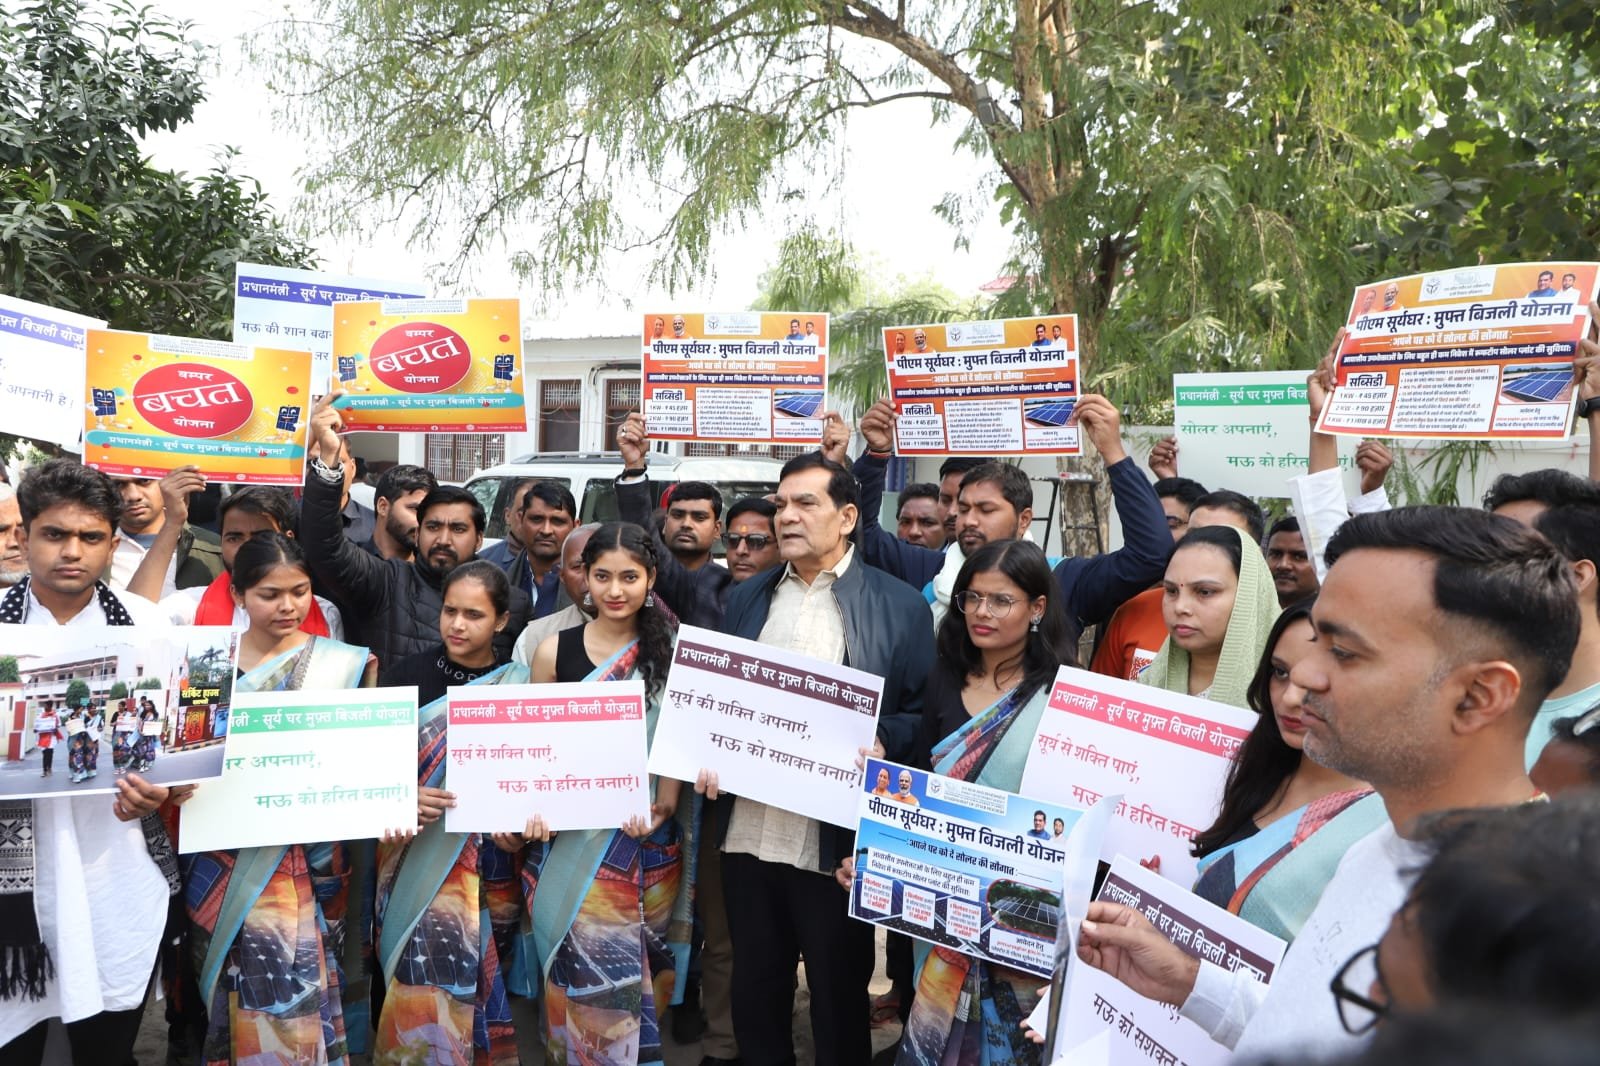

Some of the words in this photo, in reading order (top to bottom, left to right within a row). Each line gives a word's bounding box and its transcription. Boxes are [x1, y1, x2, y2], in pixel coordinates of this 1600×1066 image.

[242, 281, 290, 296] प्रधानमंत्री
[300, 286, 316, 301] सूर्य
[319, 290, 332, 300] घर
[1356, 316, 1384, 331] पीएम
[1387, 313, 1424, 333] सूर्यघर
[1435, 308, 1464, 329] मुफ्त
[1469, 301, 1517, 322] बिजली
[1520, 300, 1574, 318] योजना
[21, 317, 57, 338] बिजली
[241, 322, 260, 332] मऊ
[265, 322, 279, 334] की
[284, 326, 306, 338] शान
[405, 329, 434, 338] बम्पर
[373, 336, 461, 372] बचत
[653, 341, 678, 354] पीएम
[681, 341, 712, 358] सूर्यघर
[719, 343, 742, 358] मुफ्त
[745, 341, 779, 355] बिजली
[782, 341, 816, 355] योजना
[897, 355, 922, 369] पीएम
[925, 354, 955, 372] सूर्यघर
[964, 354, 988, 369] मुफ्त
[990, 349, 1026, 364] बिजली
[1030, 348, 1065, 361] योजना
[178, 370, 213, 381] बम्पर
[403, 373, 439, 383] योजना
[1350, 373, 1383, 387] सब्सिडी
[7, 385, 53, 403] अपनानी
[136, 382, 243, 413] बचत
[655, 390, 682, 401] सब्सिडी
[1179, 388, 1219, 401] प्रधानमंत्री
[1230, 388, 1244, 404] सूर्य
[1247, 391, 1260, 400] घर
[905, 405, 932, 416] सब्सिडी
[173, 416, 215, 429] योजना
[1181, 421, 1218, 434] सोलर
[1227, 456, 1255, 467] मऊ
[1259, 452, 1274, 466] को
[1278, 452, 1309, 467] हरित
[680, 647, 731, 669] प्रधानमंत्री
[741, 659, 759, 679] सूर्य
[761, 668, 776, 681] घर
[805, 675, 839, 698] बिजली
[841, 686, 874, 709] योजना
[453, 703, 496, 718] प्रधानमंत्री
[507, 701, 522, 720] सूर्य
[525, 706, 540, 716] घर
[567, 700, 601, 715] बिजली
[604, 699, 637, 714] योजना
[669, 688, 695, 709] सूर्य
[696, 694, 716, 710] की
[718, 700, 755, 722] शक्ति
[1055, 689, 1098, 711] प्रधानमंत्री
[1107, 701, 1126, 723] सूर्य
[1126, 710, 1139, 723] घर
[1168, 717, 1207, 742] बिजली
[262, 709, 281, 730] सूर्य
[285, 713, 302, 724] घर
[336, 710, 372, 722] बिजली
[375, 708, 410, 721] योजना
[451, 744, 472, 766] सूर्य
[476, 745, 486, 759] से
[490, 743, 524, 760] शक्ति
[710, 731, 742, 753] मऊ
[747, 739, 766, 759] को
[769, 749, 816, 773] सशक्त
[1038, 732, 1060, 755] सूर्य
[1060, 736, 1072, 757] से
[1074, 743, 1110, 768] शक्ति
[497, 780, 528, 793] मऊ
[533, 775, 552, 791] को
[555, 774, 592, 791] हरित
[254, 794, 293, 809] मऊ
[298, 787, 317, 804] को
[322, 785, 359, 803] हरित
[1071, 784, 1103, 806] मऊ
[1129, 803, 1168, 832] हरित
[869, 797, 897, 821] पीएम
[900, 806, 937, 830] सूर्यघर
[946, 821, 976, 843] मुफ्त
[979, 827, 1024, 855] बिजली
[1027, 840, 1065, 864] योजन
[956, 850, 977, 866] सोलर
[978, 855, 988, 869] की
[1159, 917, 1170, 931] घर
[1191, 928, 1226, 967] बिजली
[1094, 993, 1118, 1024] मऊ
[1118, 1011, 1134, 1038] को
[1134, 1027, 1178, 1066] सशक्त
